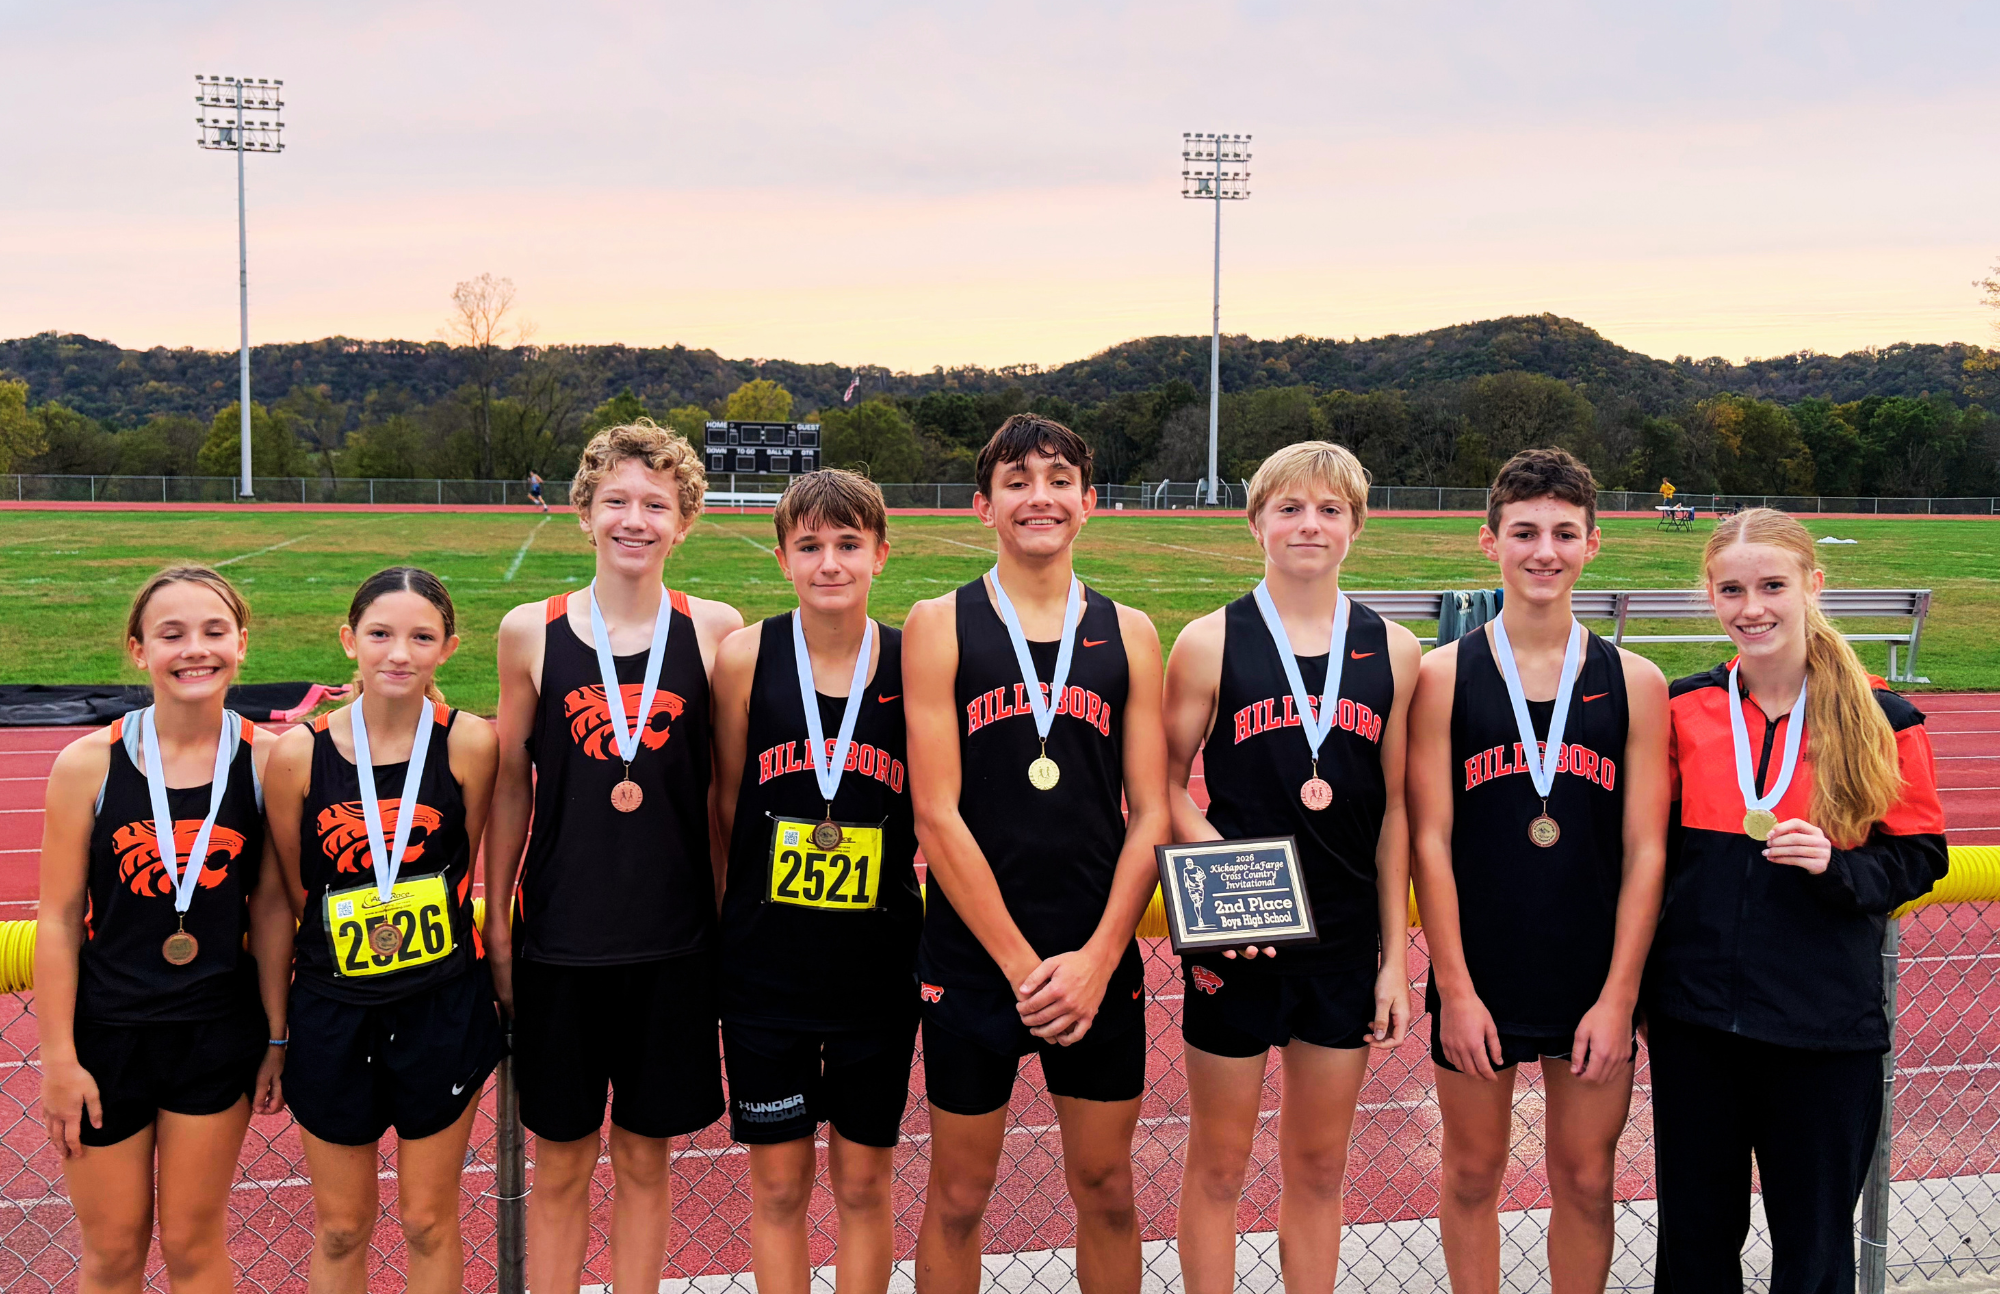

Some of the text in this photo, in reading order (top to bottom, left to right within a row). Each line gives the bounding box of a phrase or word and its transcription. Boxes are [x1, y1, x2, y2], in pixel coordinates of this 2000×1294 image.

[1233, 694, 1382, 746] HILLORO
[1210, 861, 1283, 873] Kickapoo-LaFarge
[1220, 870, 1277, 881] Cross Country
[776, 850, 870, 903] 2521
[1226, 877, 1275, 889] Invitational
[1214, 897, 1293, 915] 2nd Place
[1220, 911, 1292, 930] Boys High School
[750, 1094, 804, 1112] UNDER
[741, 1105, 807, 1123] ARMOUR
